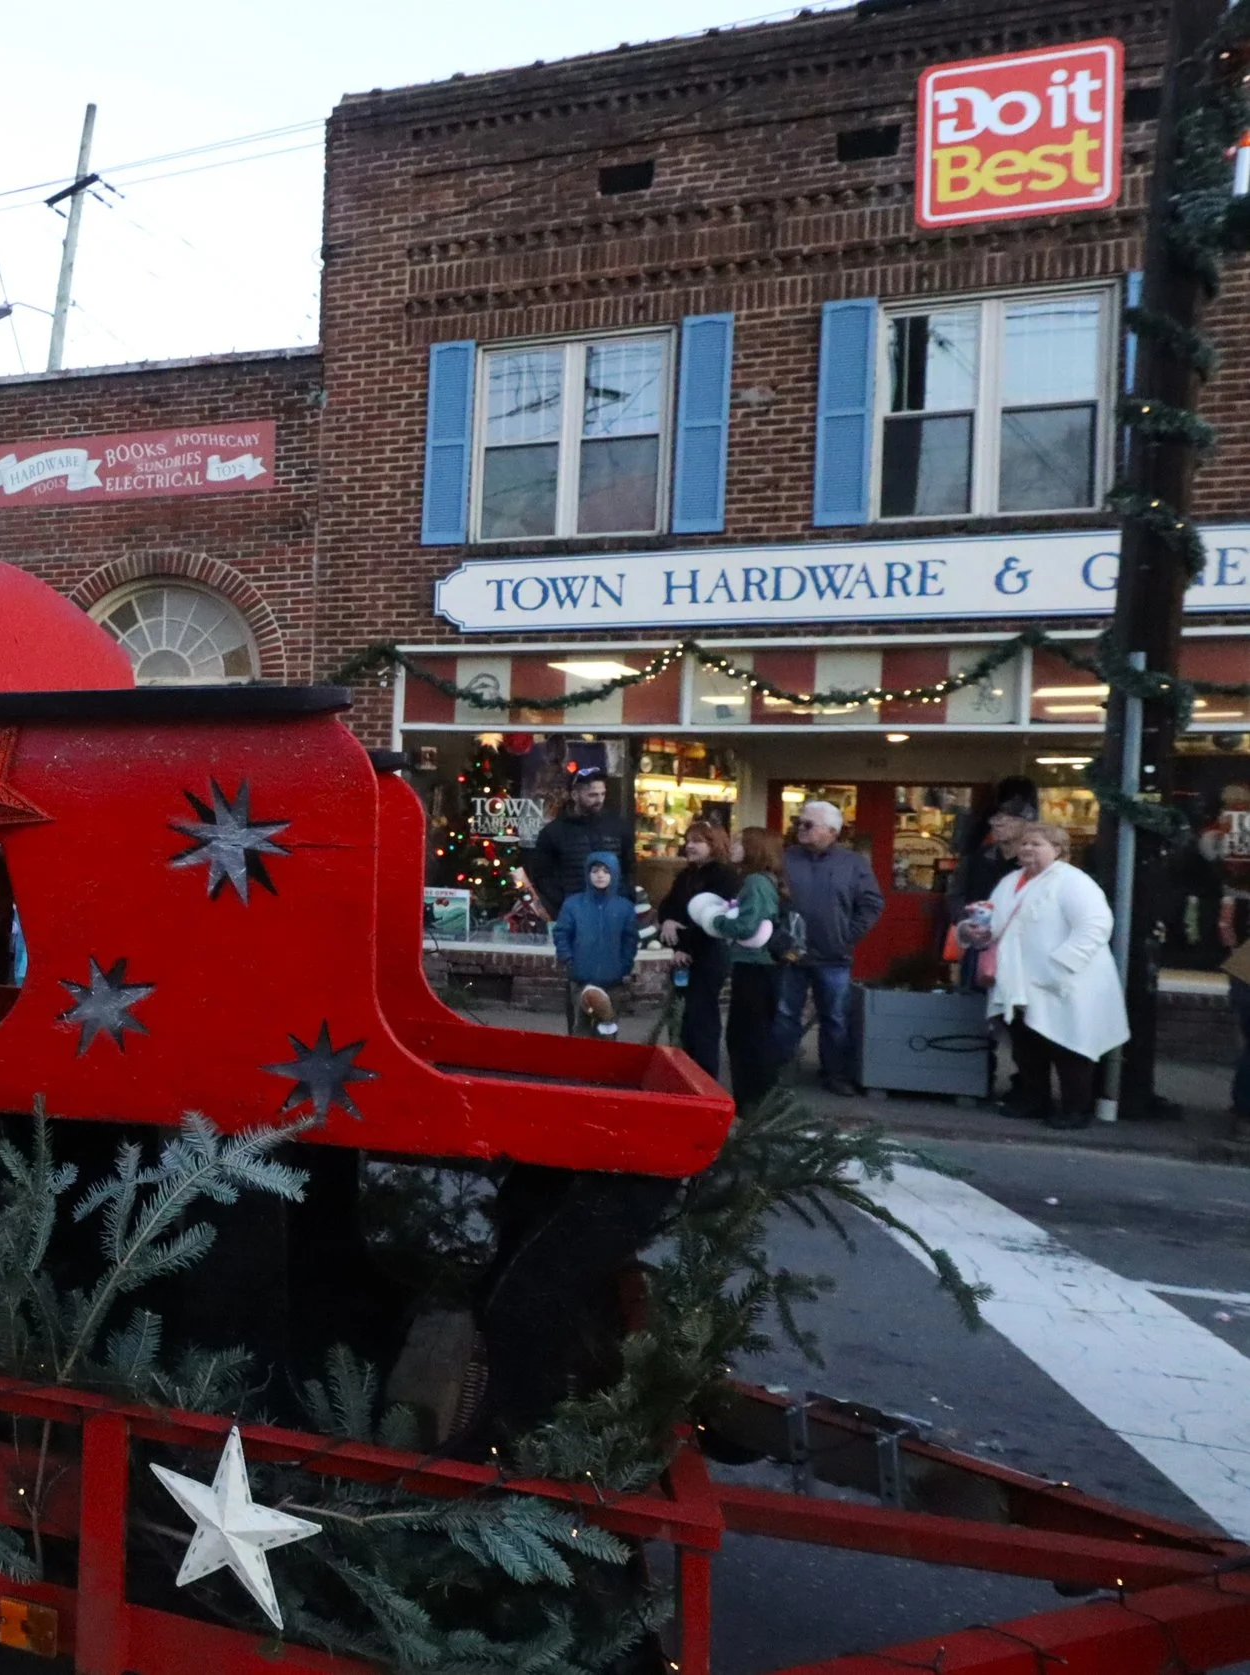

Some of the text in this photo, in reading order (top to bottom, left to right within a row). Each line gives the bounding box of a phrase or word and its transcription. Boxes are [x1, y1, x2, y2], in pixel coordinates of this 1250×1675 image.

[934, 68, 1103, 144] Do it
[932, 128, 1101, 203] Best
[174, 432, 261, 448] APOTHECARY
[105, 442, 167, 469] BOOKS
[136, 451, 202, 474] SUNDRIES
[10, 455, 81, 486] HARDWARE
[105, 471, 204, 492] ELECTRICAL
[215, 463, 247, 478] TOYS
[32, 478, 67, 496] TOOLS
[486, 573, 626, 612] TOWN
[662, 559, 948, 606] HARDWARE
[994, 556, 1034, 596] &
[470, 797, 546, 817] TOWN
[470, 816, 543, 829] HARDWARE
